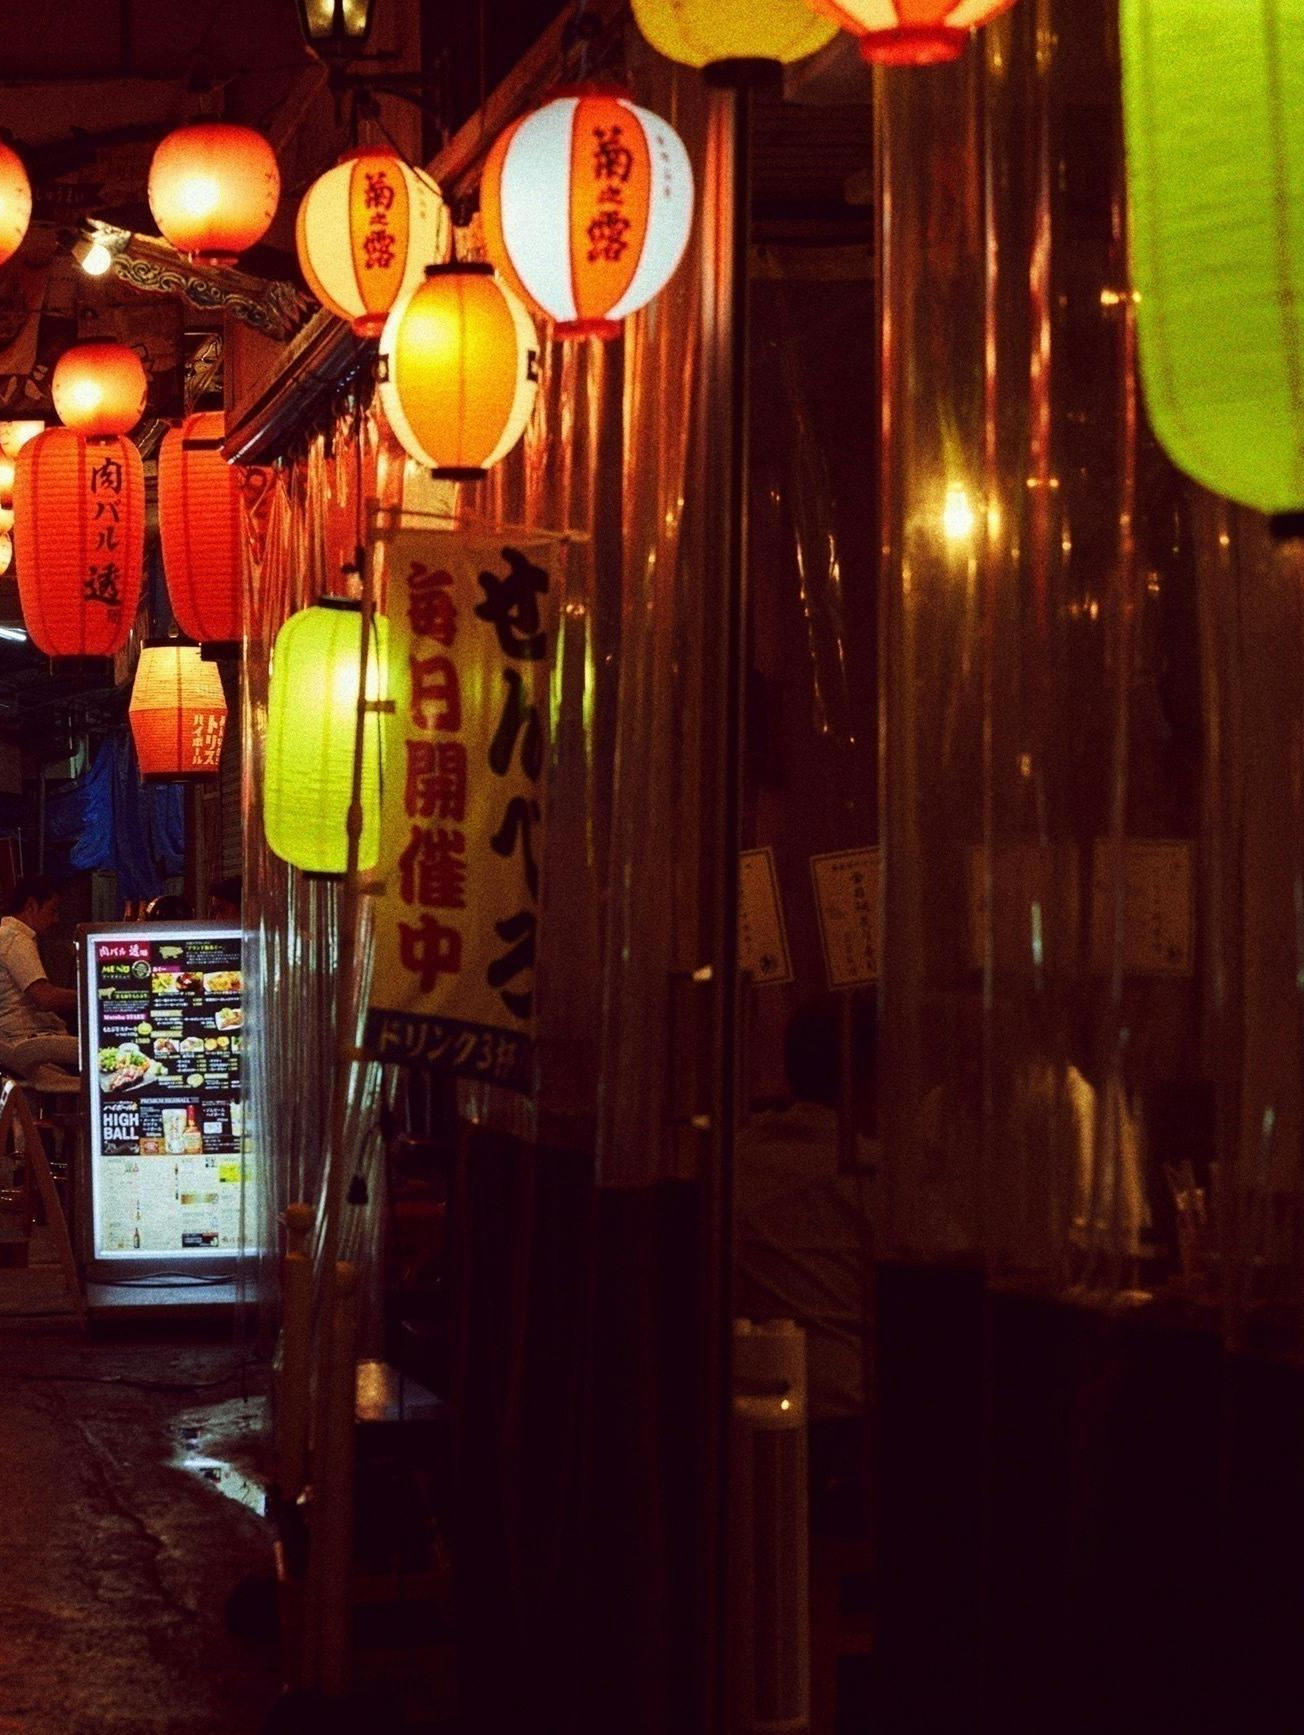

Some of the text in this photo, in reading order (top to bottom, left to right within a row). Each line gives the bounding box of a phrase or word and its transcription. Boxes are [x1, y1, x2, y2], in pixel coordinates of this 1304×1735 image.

[585, 125, 633, 263] 菊之露
[363, 171, 396, 271] 菊之露
[191, 714, 203, 765] ハイボール
[204, 715, 218, 765] トリス
[399, 562, 467, 993] 毎日開催中
[99, 946, 126, 957] 肉バル
[103, 1113, 139, 1127] HIGH
[103, 1127, 139, 1140] BALL
